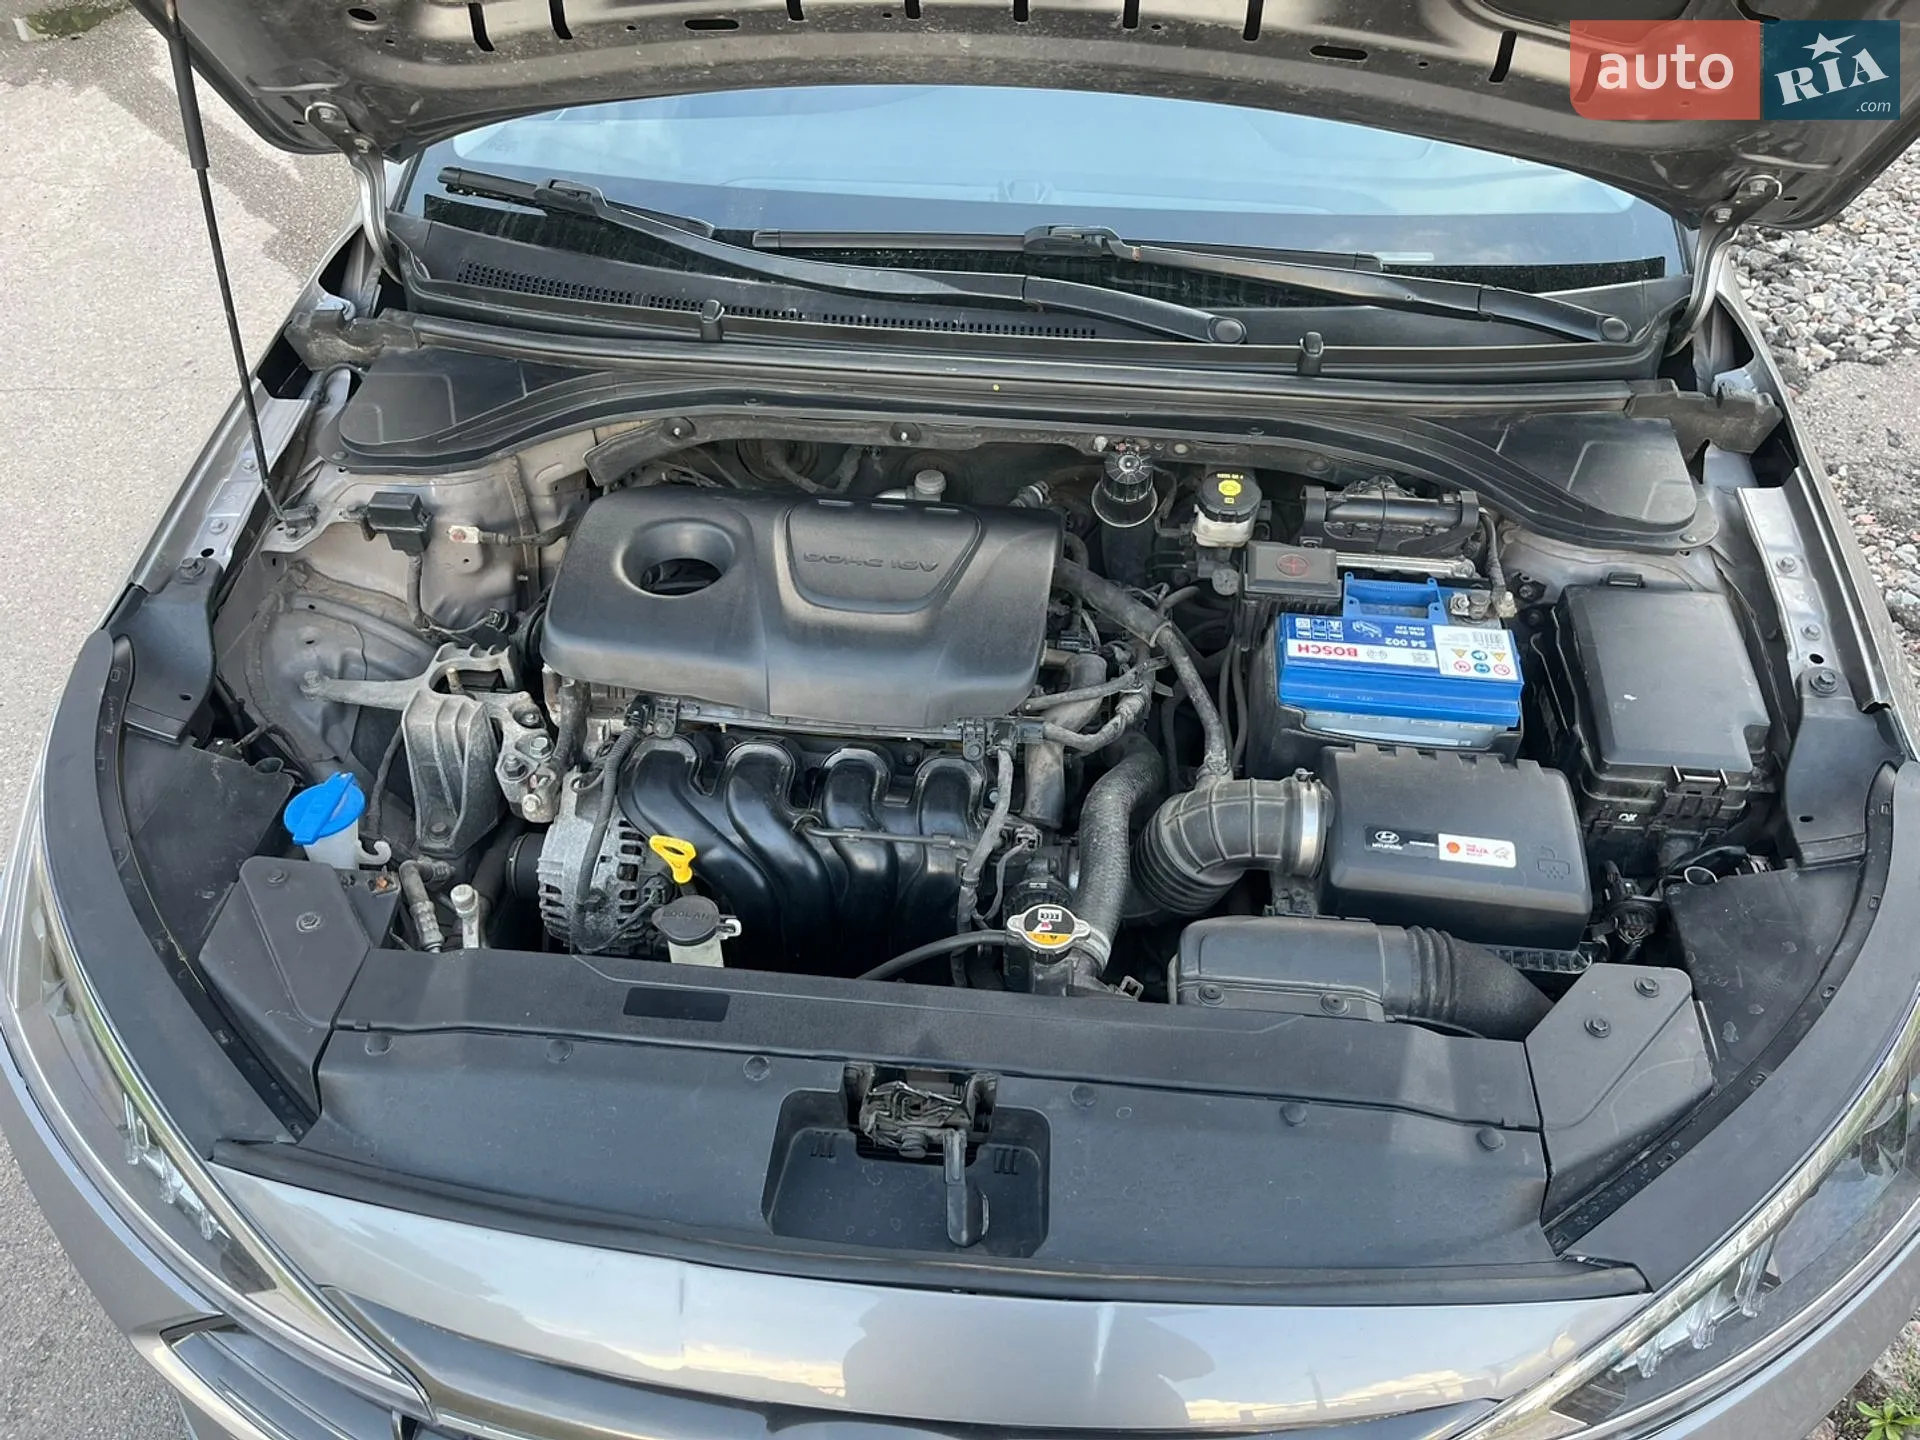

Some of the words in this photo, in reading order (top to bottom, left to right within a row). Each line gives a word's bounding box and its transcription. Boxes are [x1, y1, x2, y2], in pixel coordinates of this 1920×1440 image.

[1384, 637, 1408, 646] 002
[1410, 639, 1427, 648] S4
[1297, 643, 1359, 658] BOSCH
